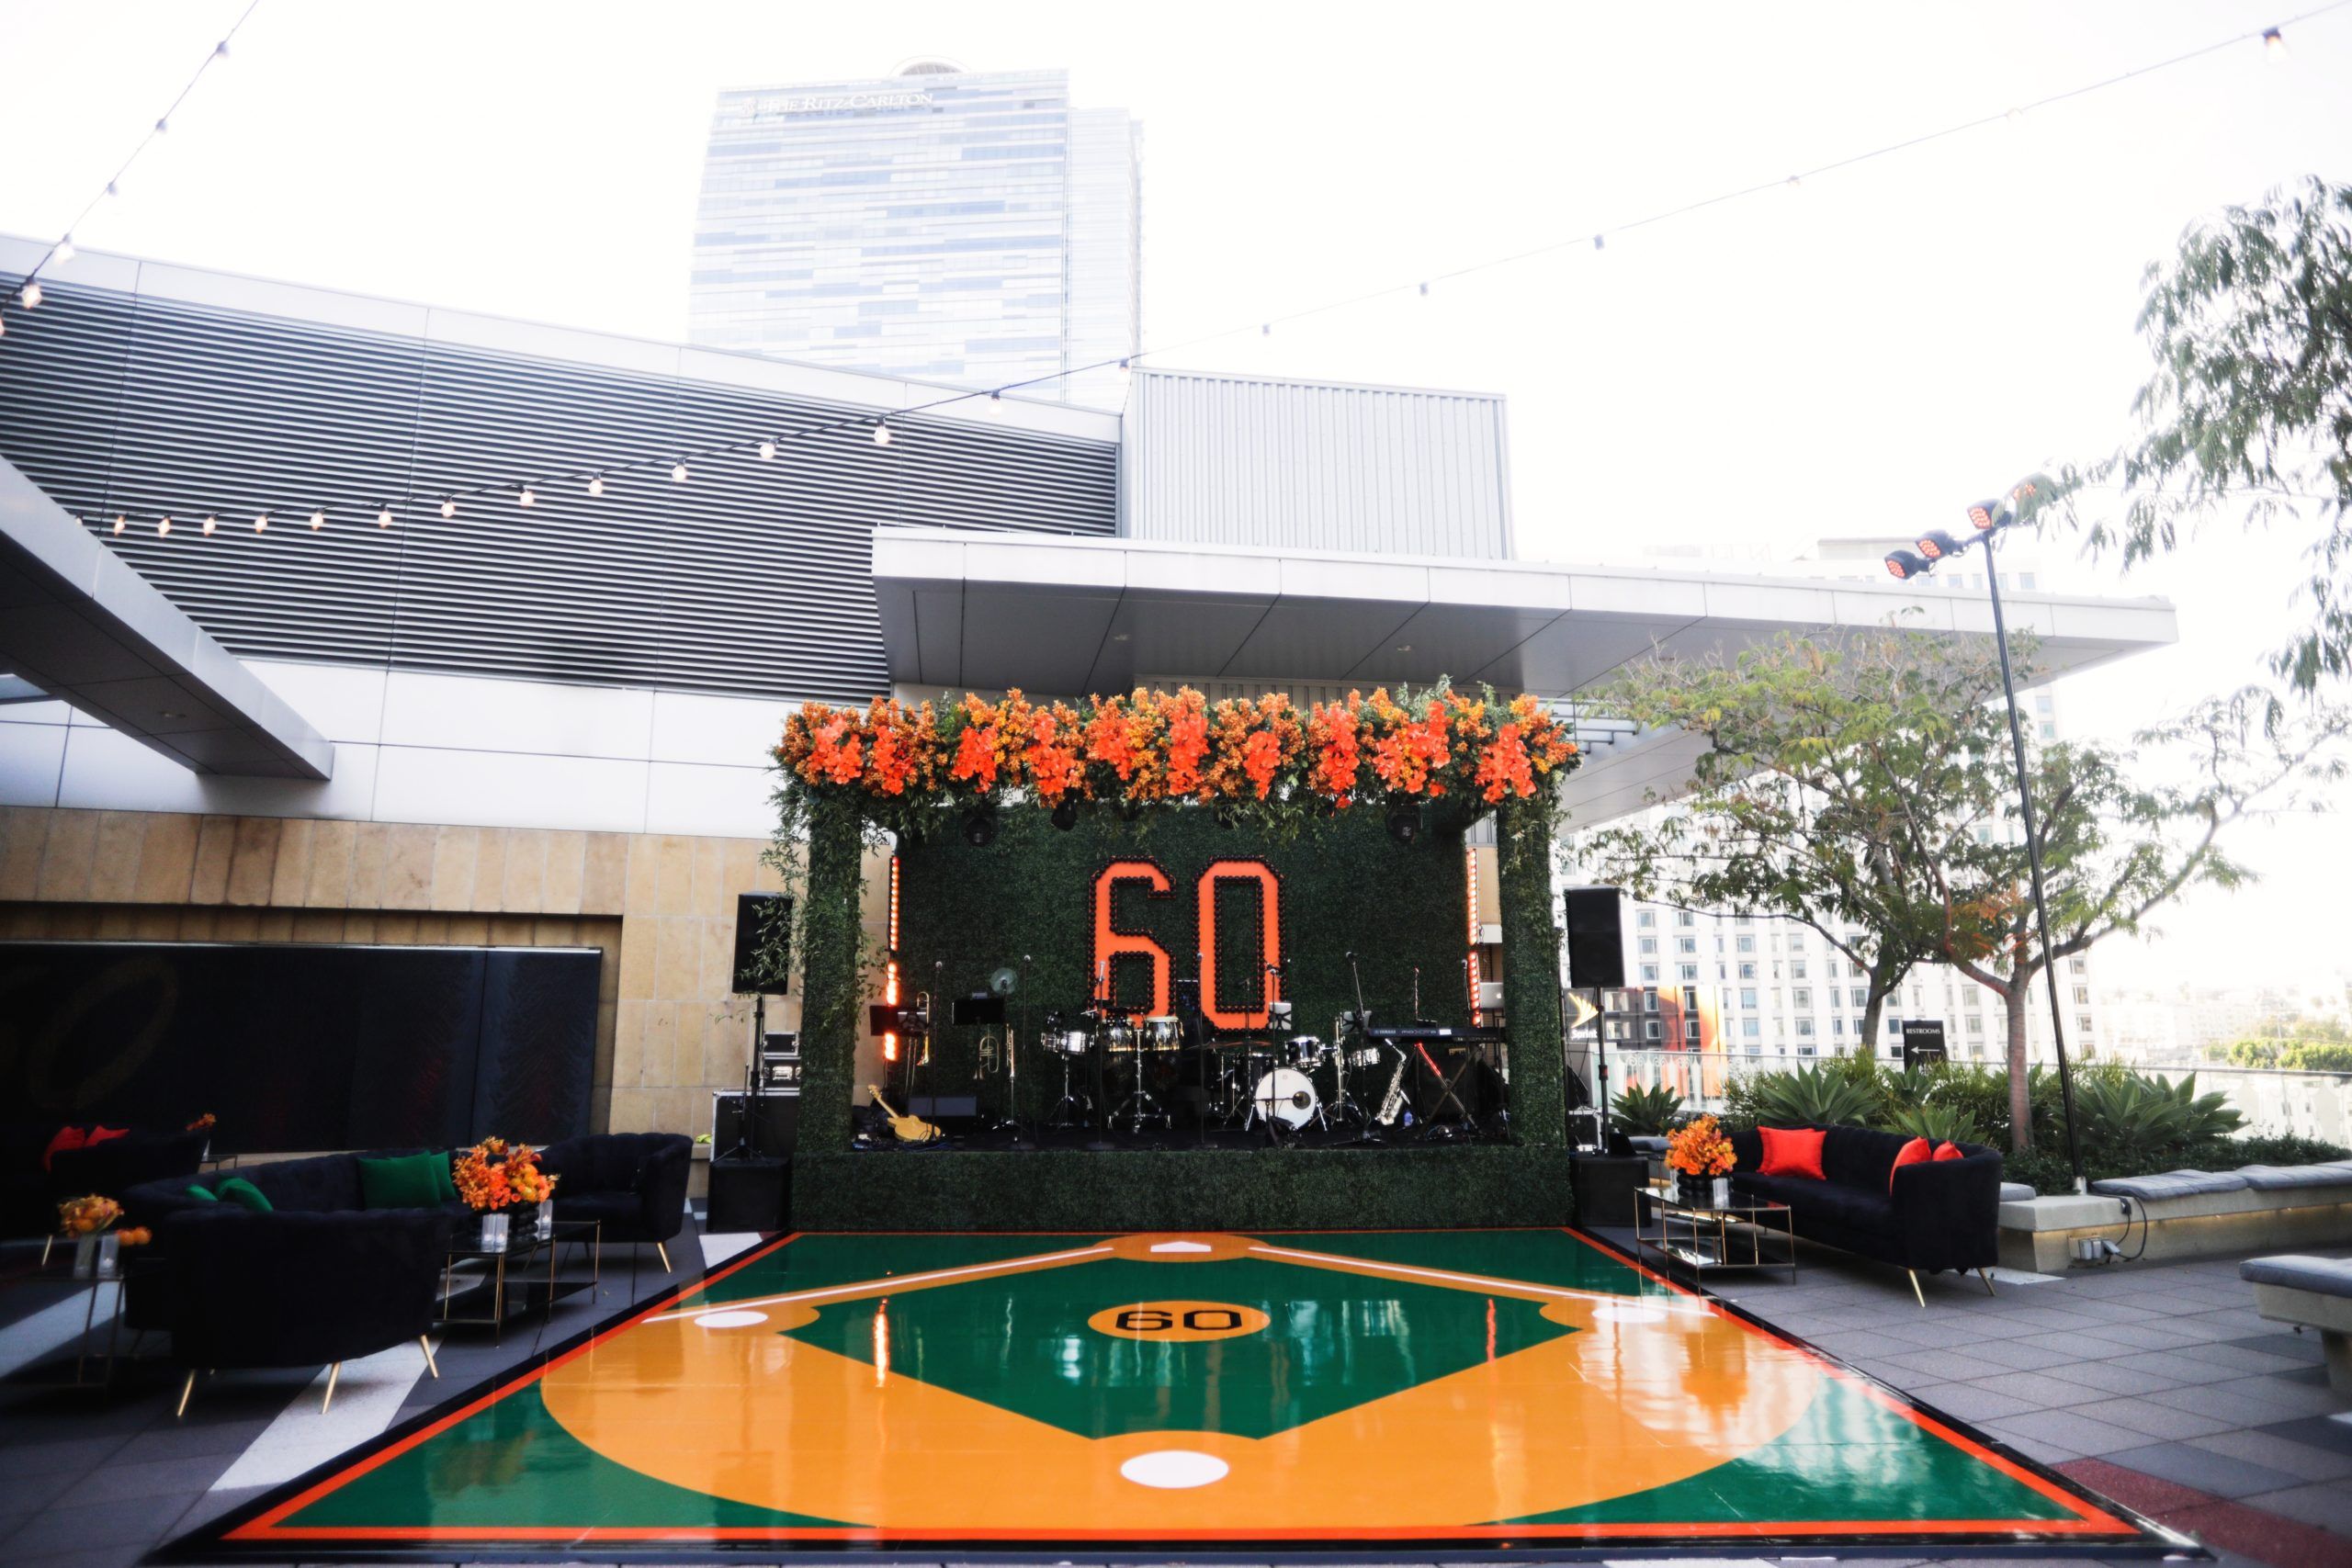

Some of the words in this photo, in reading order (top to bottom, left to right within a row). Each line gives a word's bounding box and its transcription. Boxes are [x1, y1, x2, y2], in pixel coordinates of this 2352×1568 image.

[802, 93, 933, 110] RITZ-CARLTON
[1088, 854, 1286, 1032] 60
[1571, 1029, 1598, 1041] Sprint
[1115, 1310, 1242, 1331] 60
